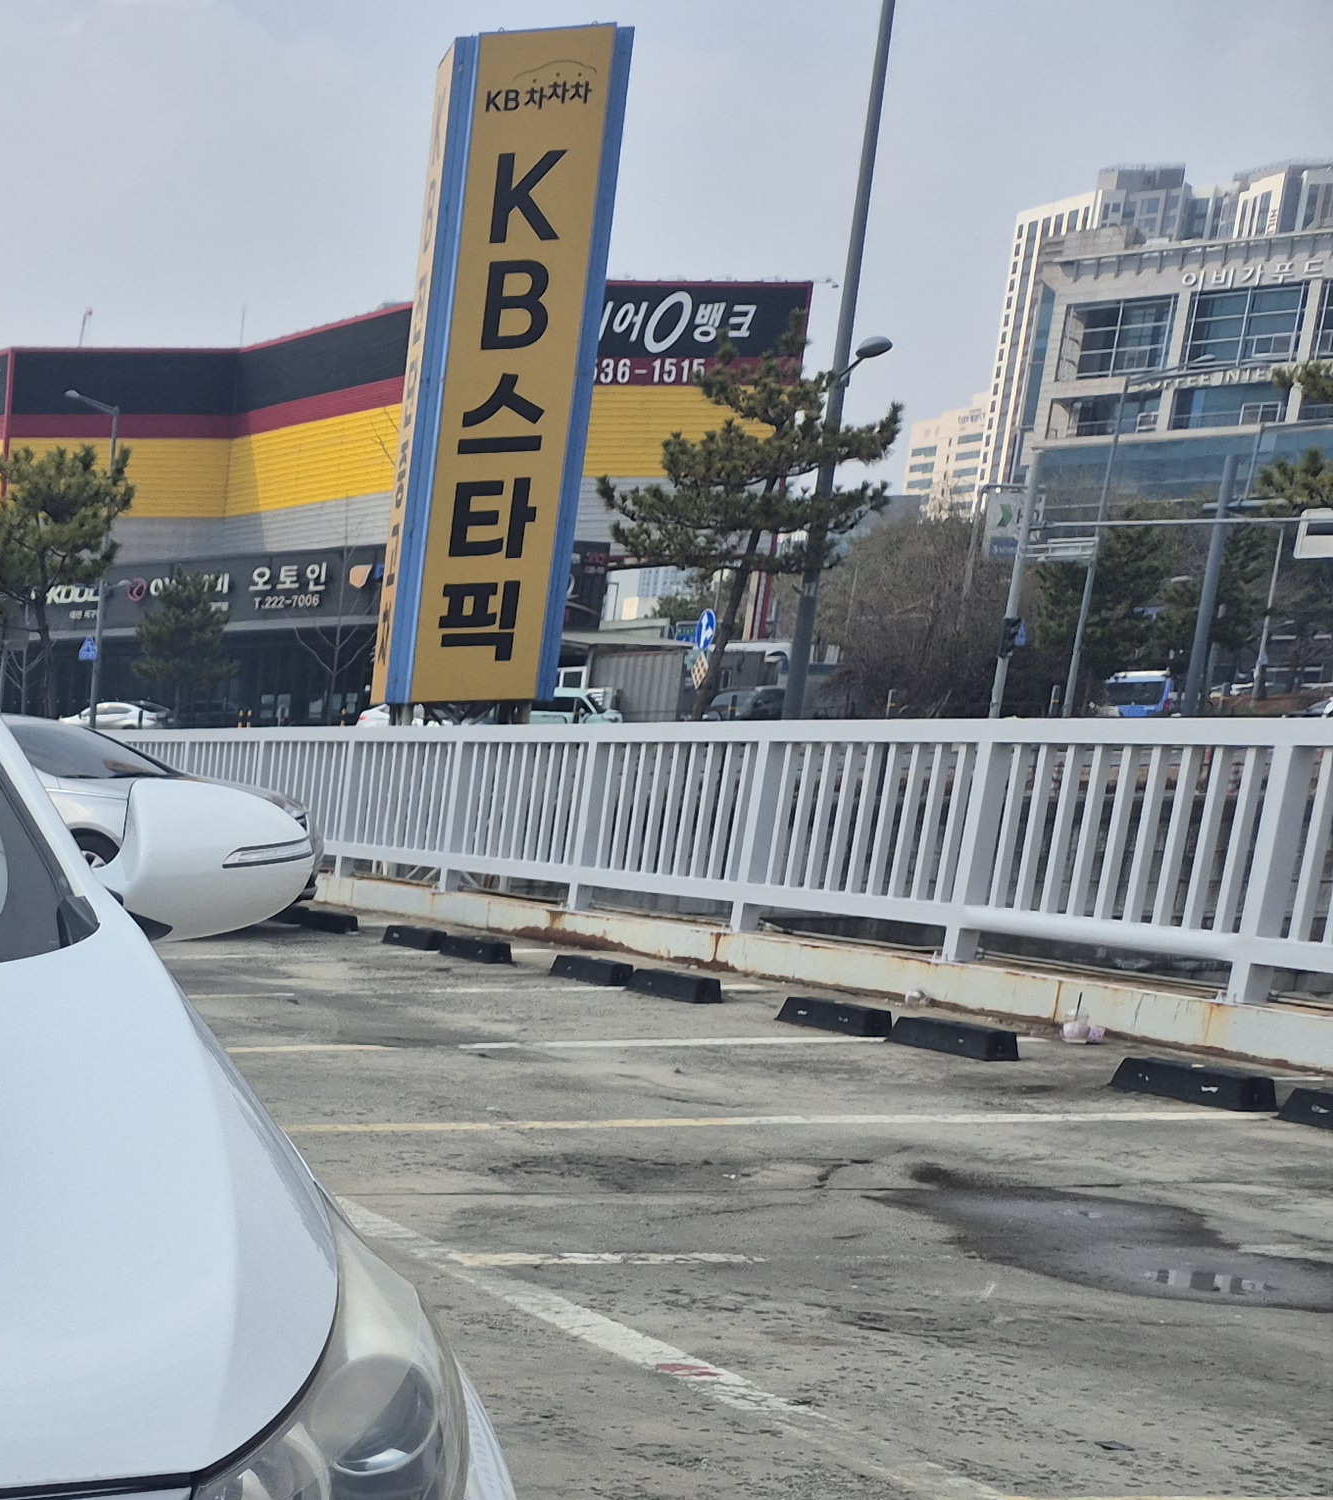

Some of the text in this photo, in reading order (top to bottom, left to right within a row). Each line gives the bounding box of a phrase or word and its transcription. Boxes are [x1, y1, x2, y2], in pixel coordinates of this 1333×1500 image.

[485, 72, 593, 113] KB 차차차
[1181, 259, 1324, 292] 이비가푸드
[593, 357, 706, 384] 36-1515
[437, 148, 569, 662] KB스타픽
[248, 561, 328, 592] 오토인
[253, 594, 321, 610] T.222-7006
